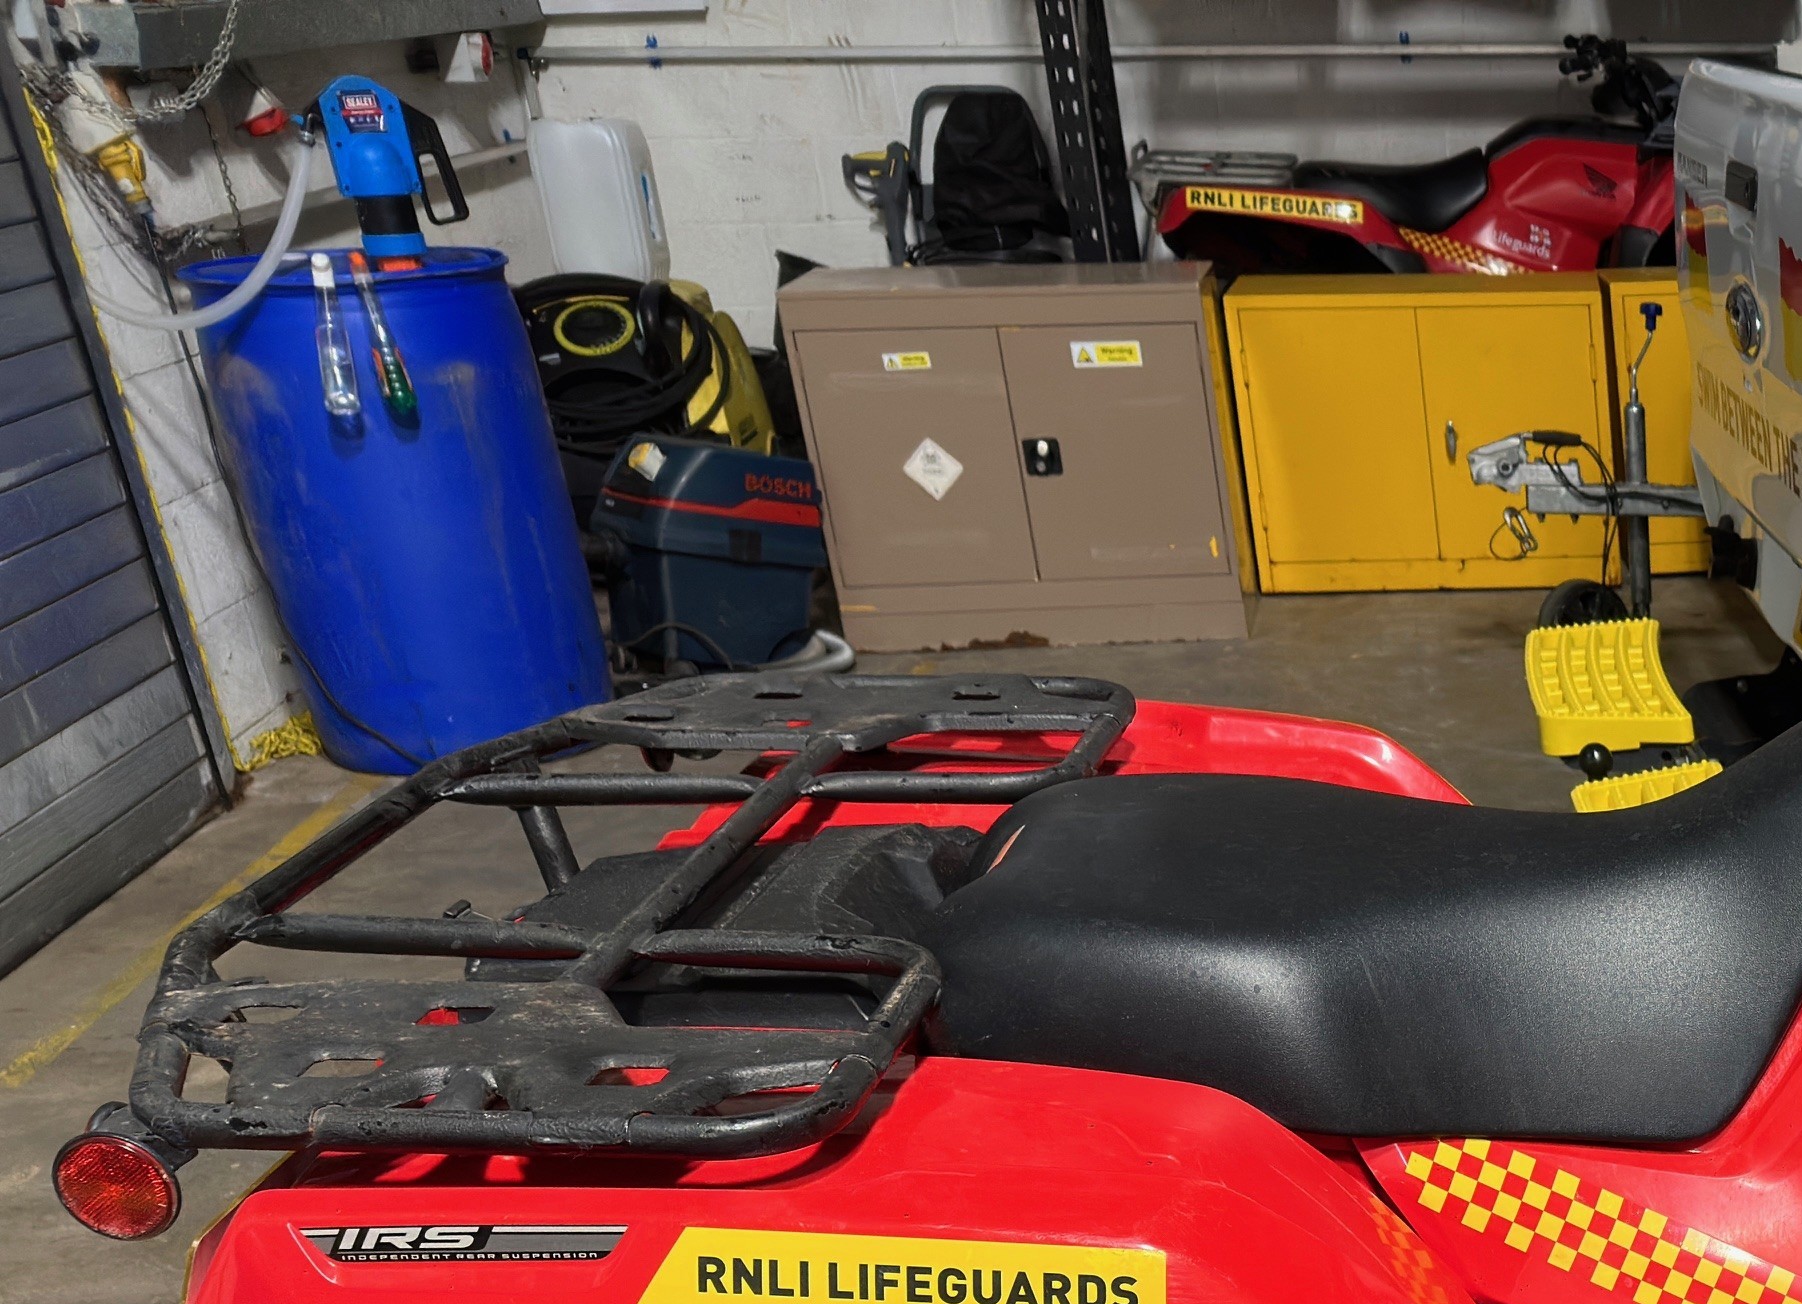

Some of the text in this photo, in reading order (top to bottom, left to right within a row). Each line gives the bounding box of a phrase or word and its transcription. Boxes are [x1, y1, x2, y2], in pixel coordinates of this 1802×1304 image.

[1190, 190, 1234, 208] RNLI
[1720, 379, 1773, 472] BETWEEN
[1773, 426, 1800, 498] THE
[745, 472, 811, 498] BOSCH
[338, 1227, 477, 1250] IRS
[341, 1252, 599, 1261] INDEPENDENT REAR SUSPENSION
[697, 1256, 810, 1298] RNLI
